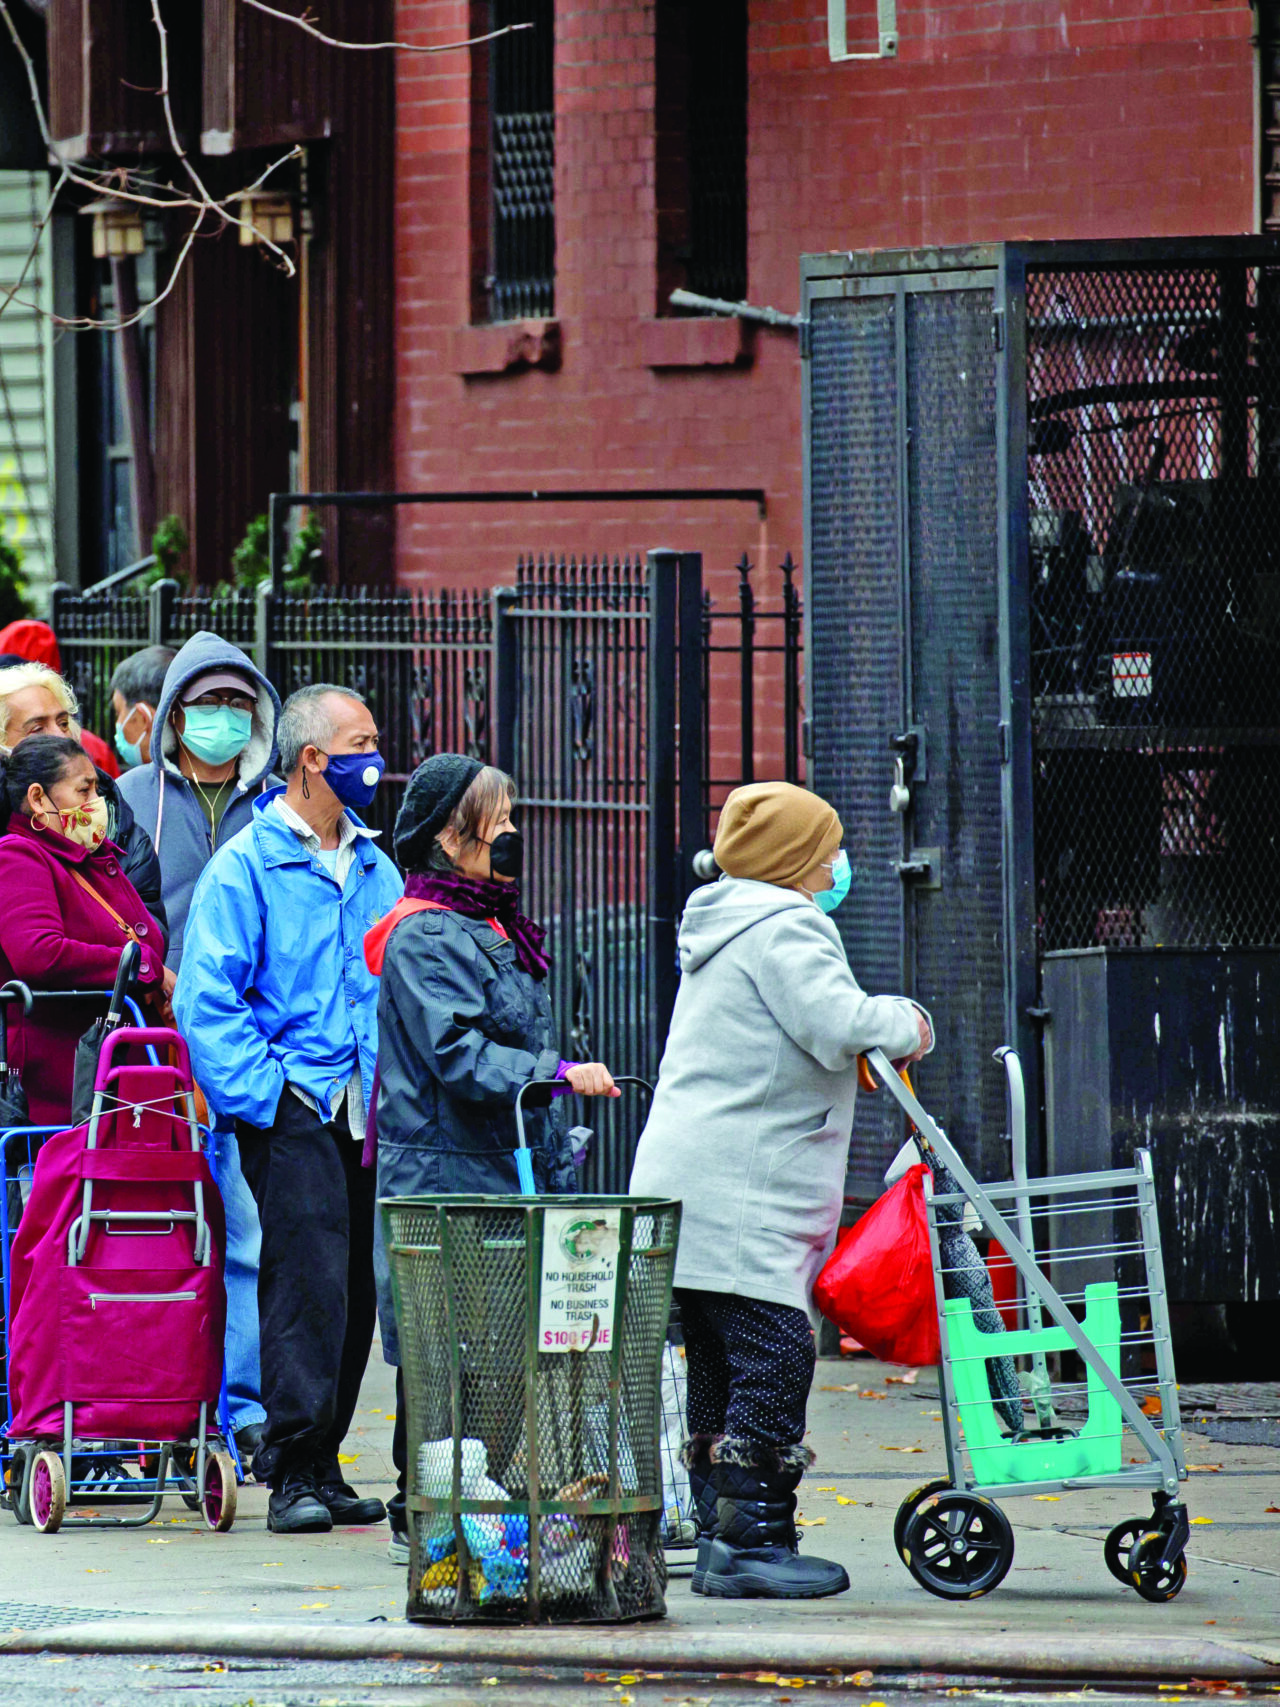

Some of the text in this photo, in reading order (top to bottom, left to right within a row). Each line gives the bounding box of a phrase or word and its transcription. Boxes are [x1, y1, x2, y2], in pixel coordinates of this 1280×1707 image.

[545, 1271, 614, 1281] NO HOUSEHOLD
[567, 1283, 596, 1292] TRASH
[551, 1299, 609, 1309] NO BUSINESS
[544, 1329, 610, 1345] $100 FNE
